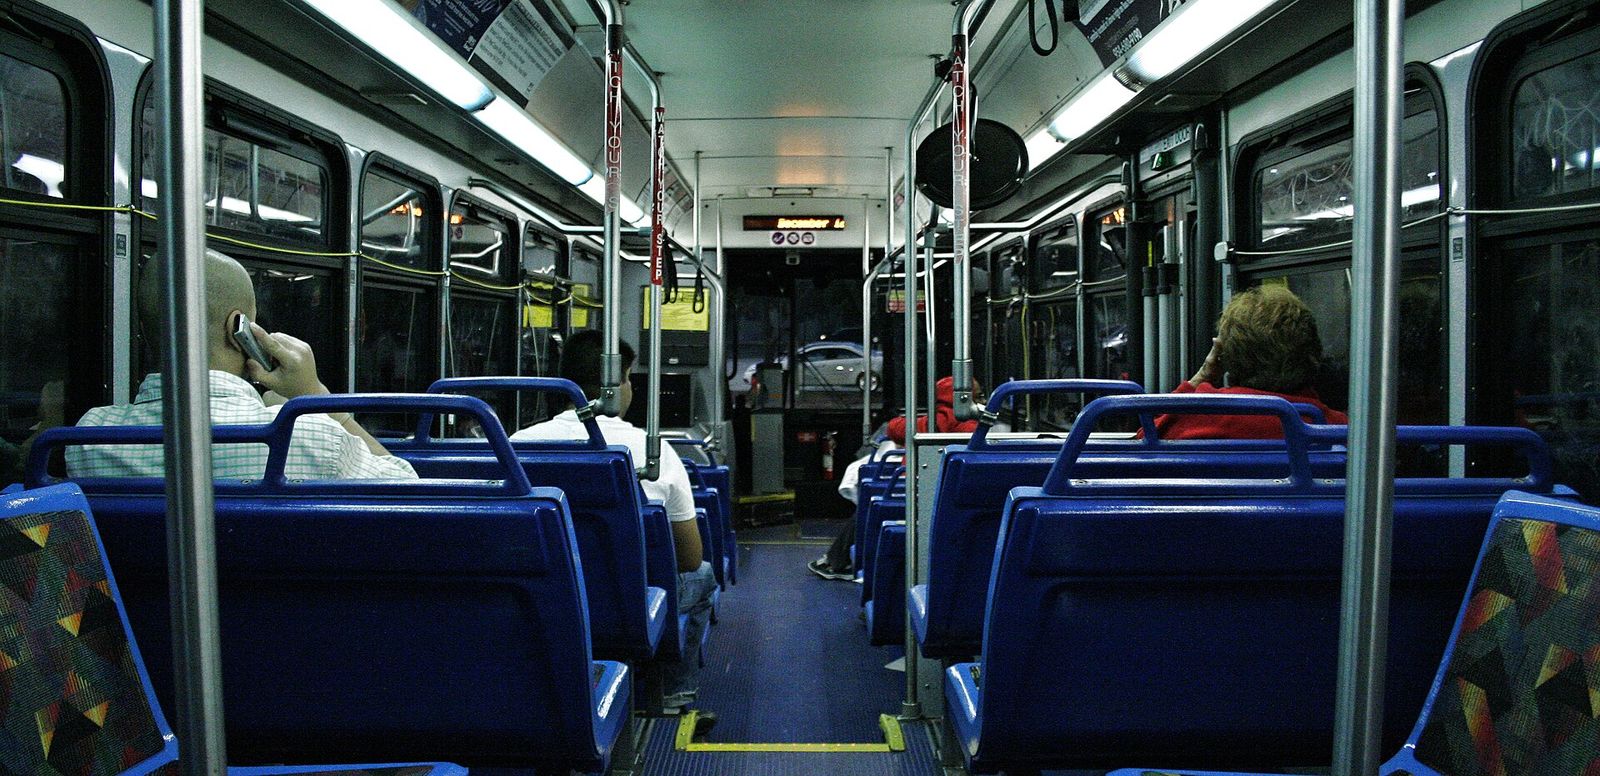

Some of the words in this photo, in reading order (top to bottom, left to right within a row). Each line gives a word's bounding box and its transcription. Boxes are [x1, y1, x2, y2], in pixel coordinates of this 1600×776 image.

[607, 120, 621, 178] YOUR
[953, 130, 965, 187] YOUR
[656, 177, 664, 226] YOUR
[777, 218, 830, 229] December
[655, 233, 663, 280] STEP
